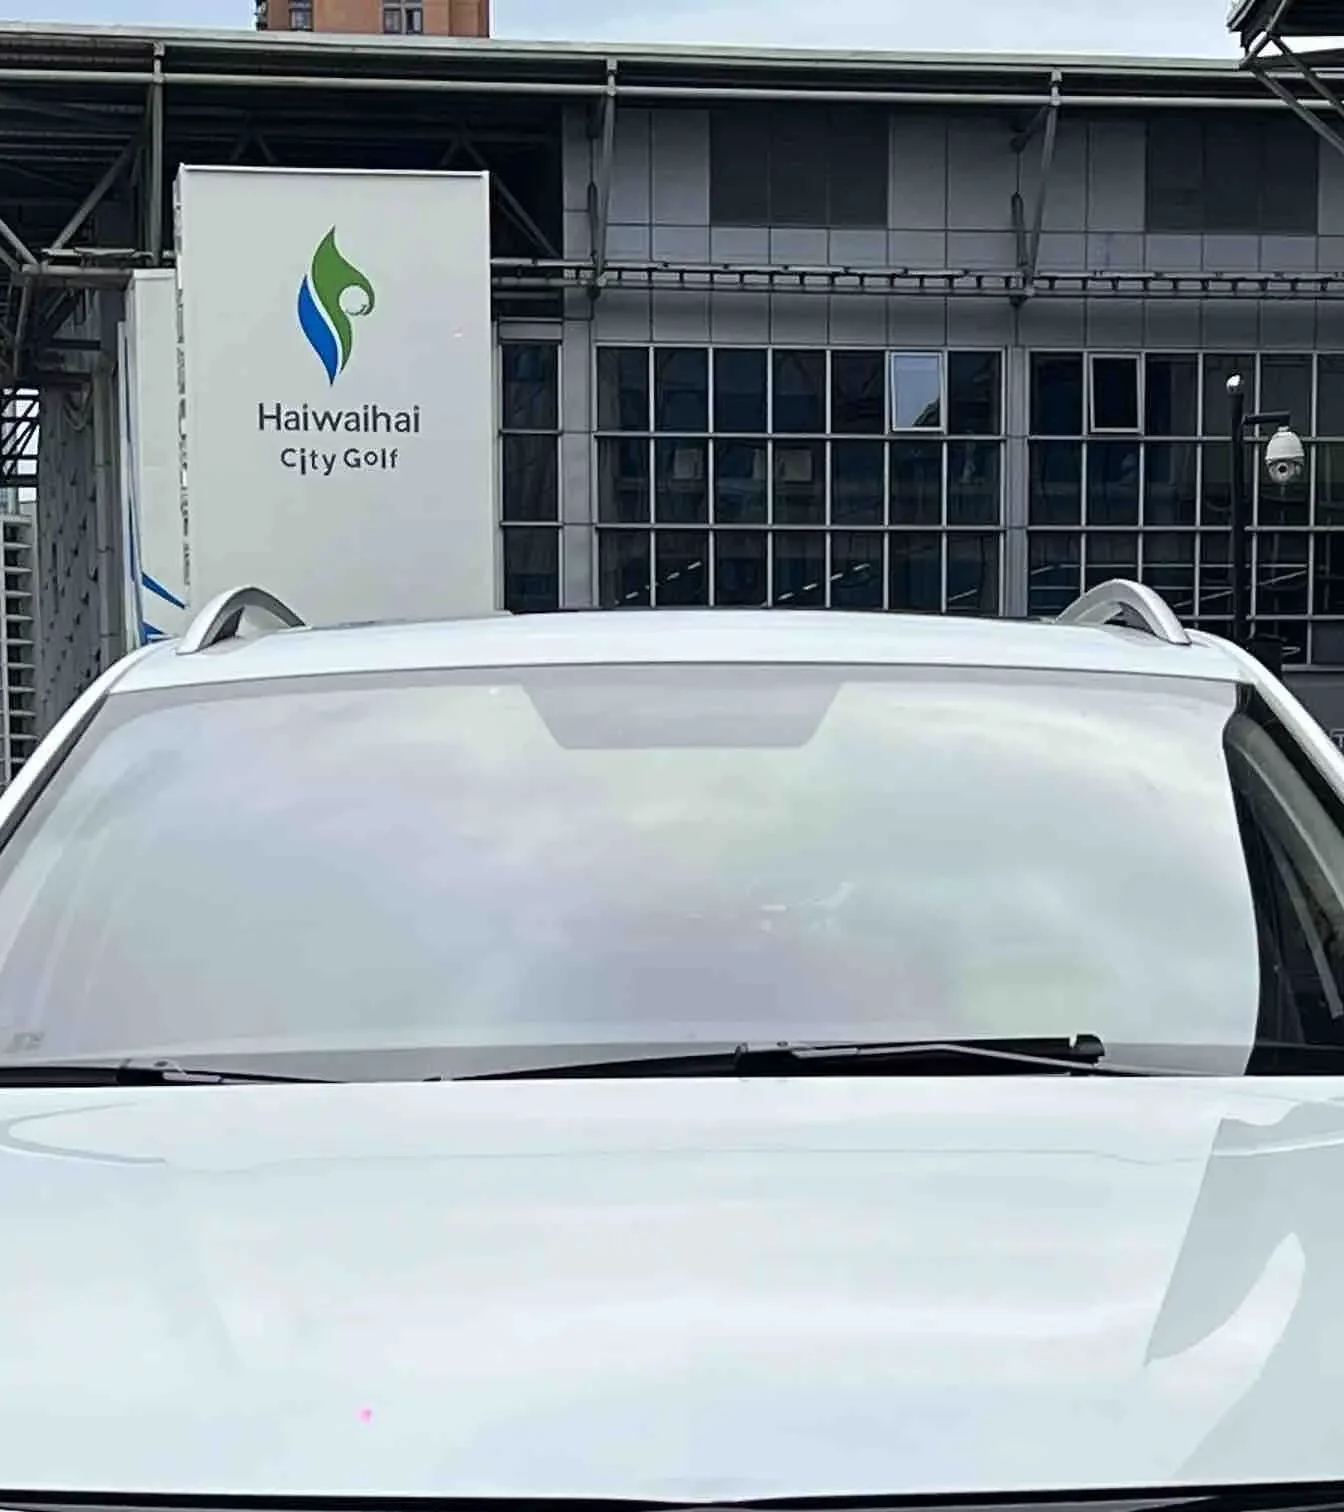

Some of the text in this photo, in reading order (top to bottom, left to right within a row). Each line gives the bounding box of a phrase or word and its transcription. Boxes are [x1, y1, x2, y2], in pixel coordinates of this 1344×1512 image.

[258, 402, 421, 433] Haiwaihai
[280, 447, 399, 476] City Golf
